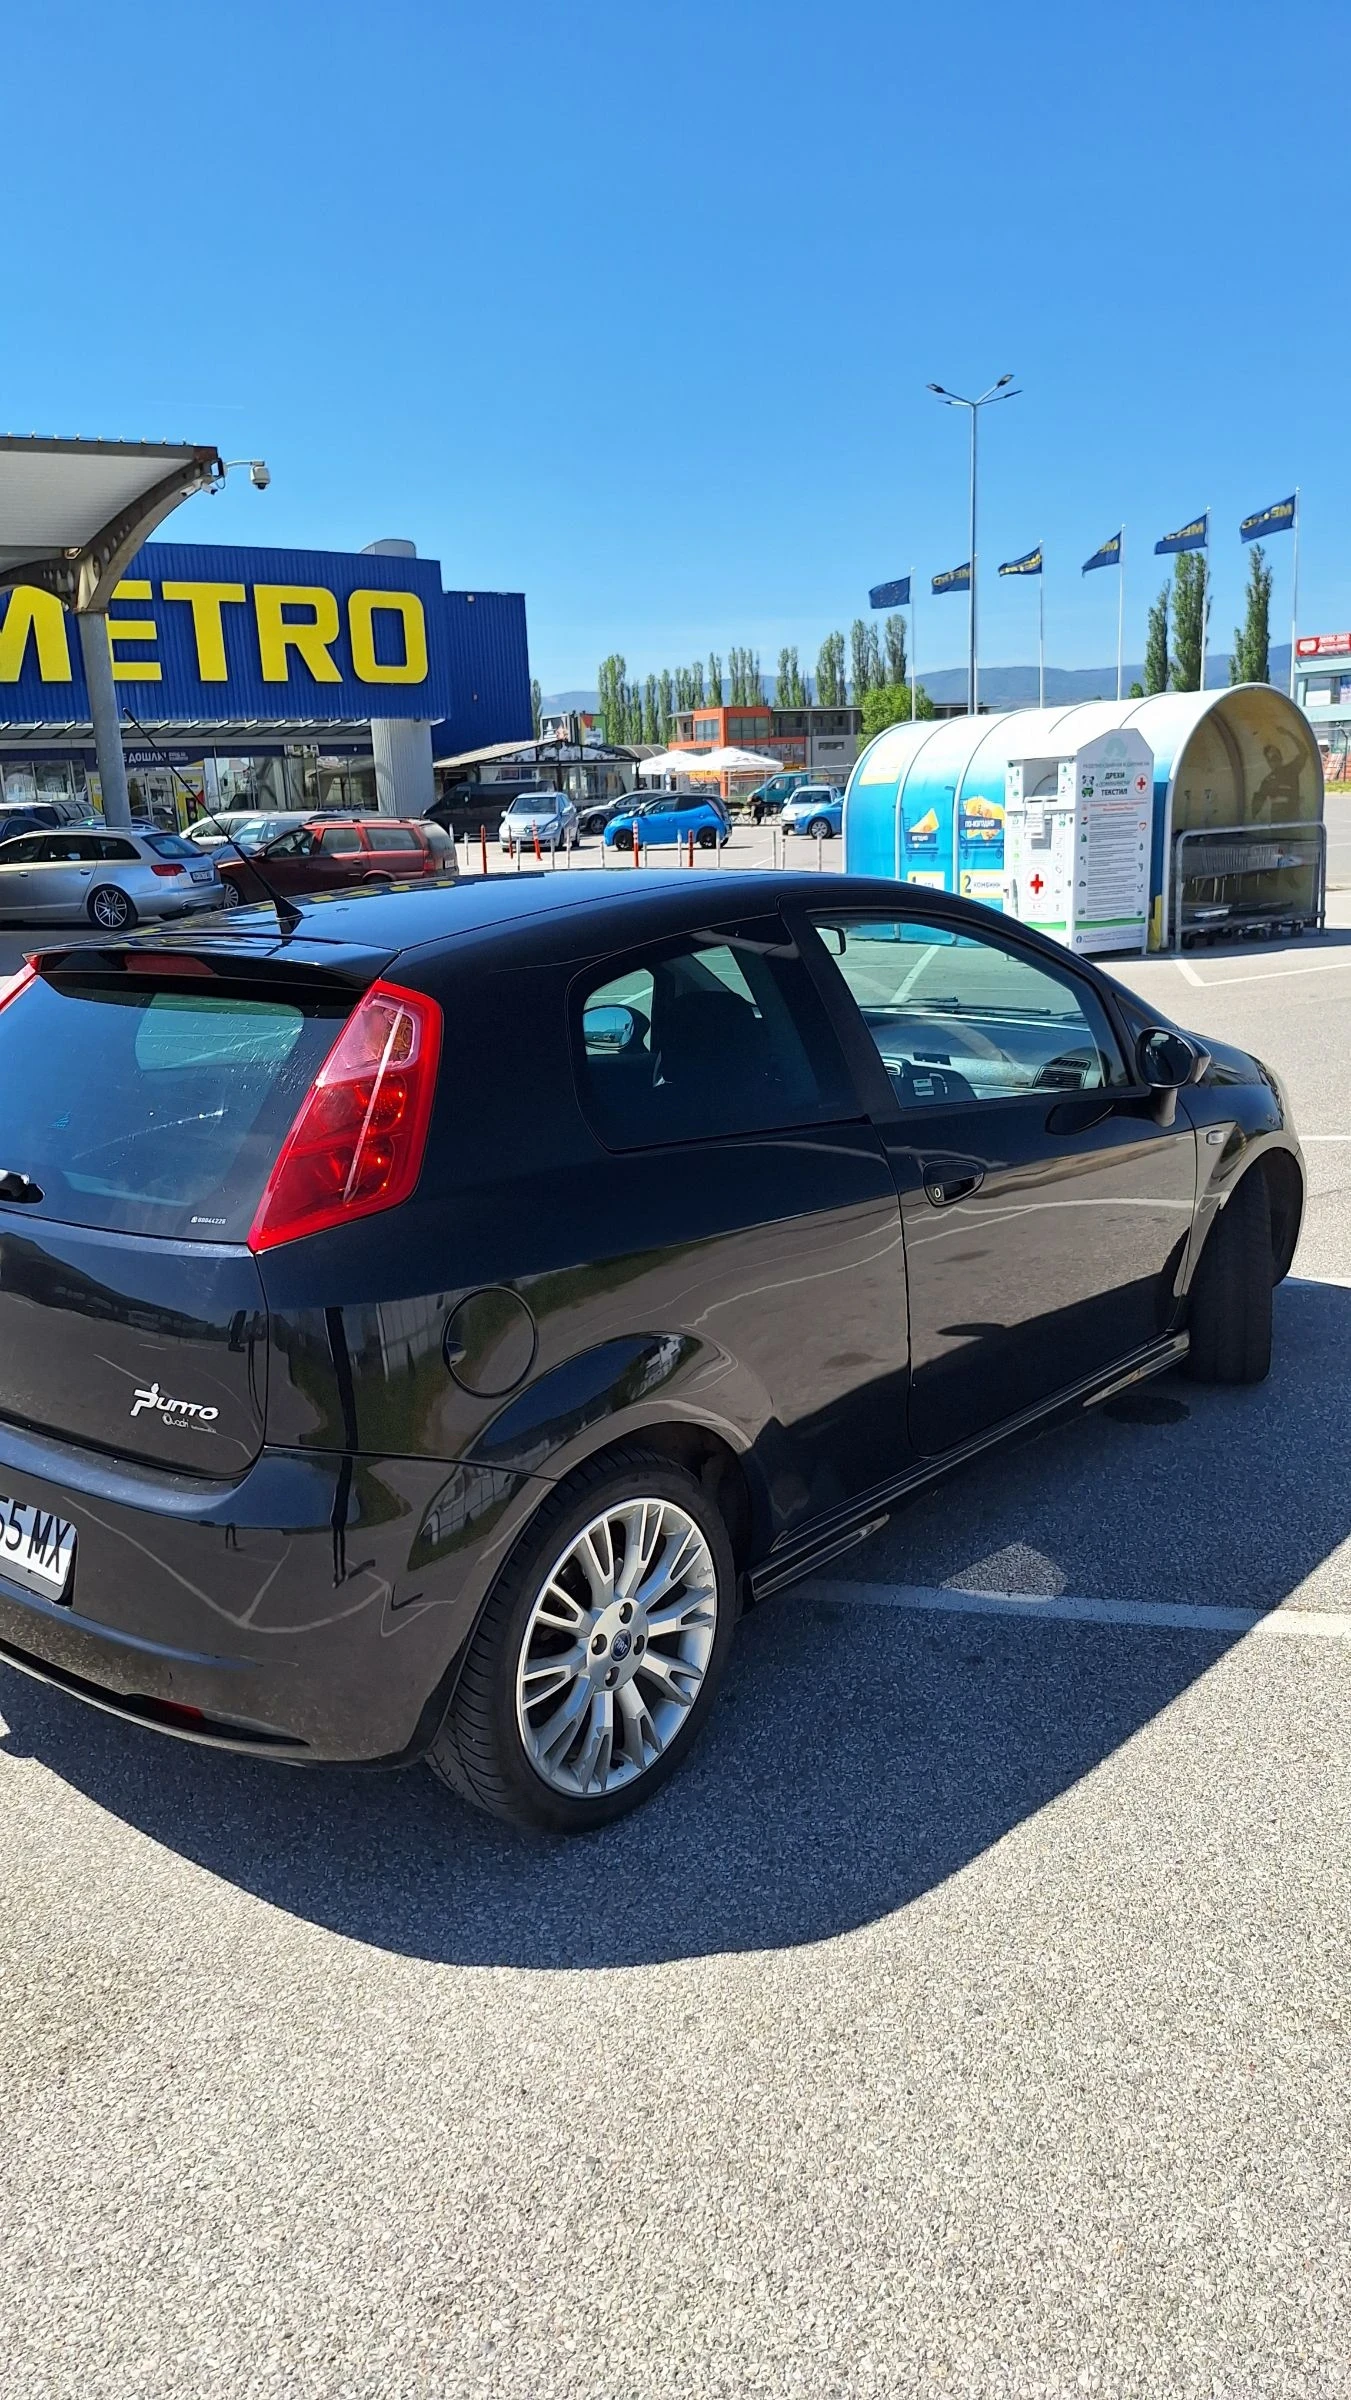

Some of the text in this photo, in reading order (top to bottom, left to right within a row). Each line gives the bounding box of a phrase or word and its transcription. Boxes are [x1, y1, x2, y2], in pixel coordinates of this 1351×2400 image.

[1105, 772, 1125, 780] ДРЕХИ
[1101, 788, 1127, 796] ТЕКСТИЛ
[965, 875, 971, 893] 2
[615, 1637, 628, 1653] FIAT
